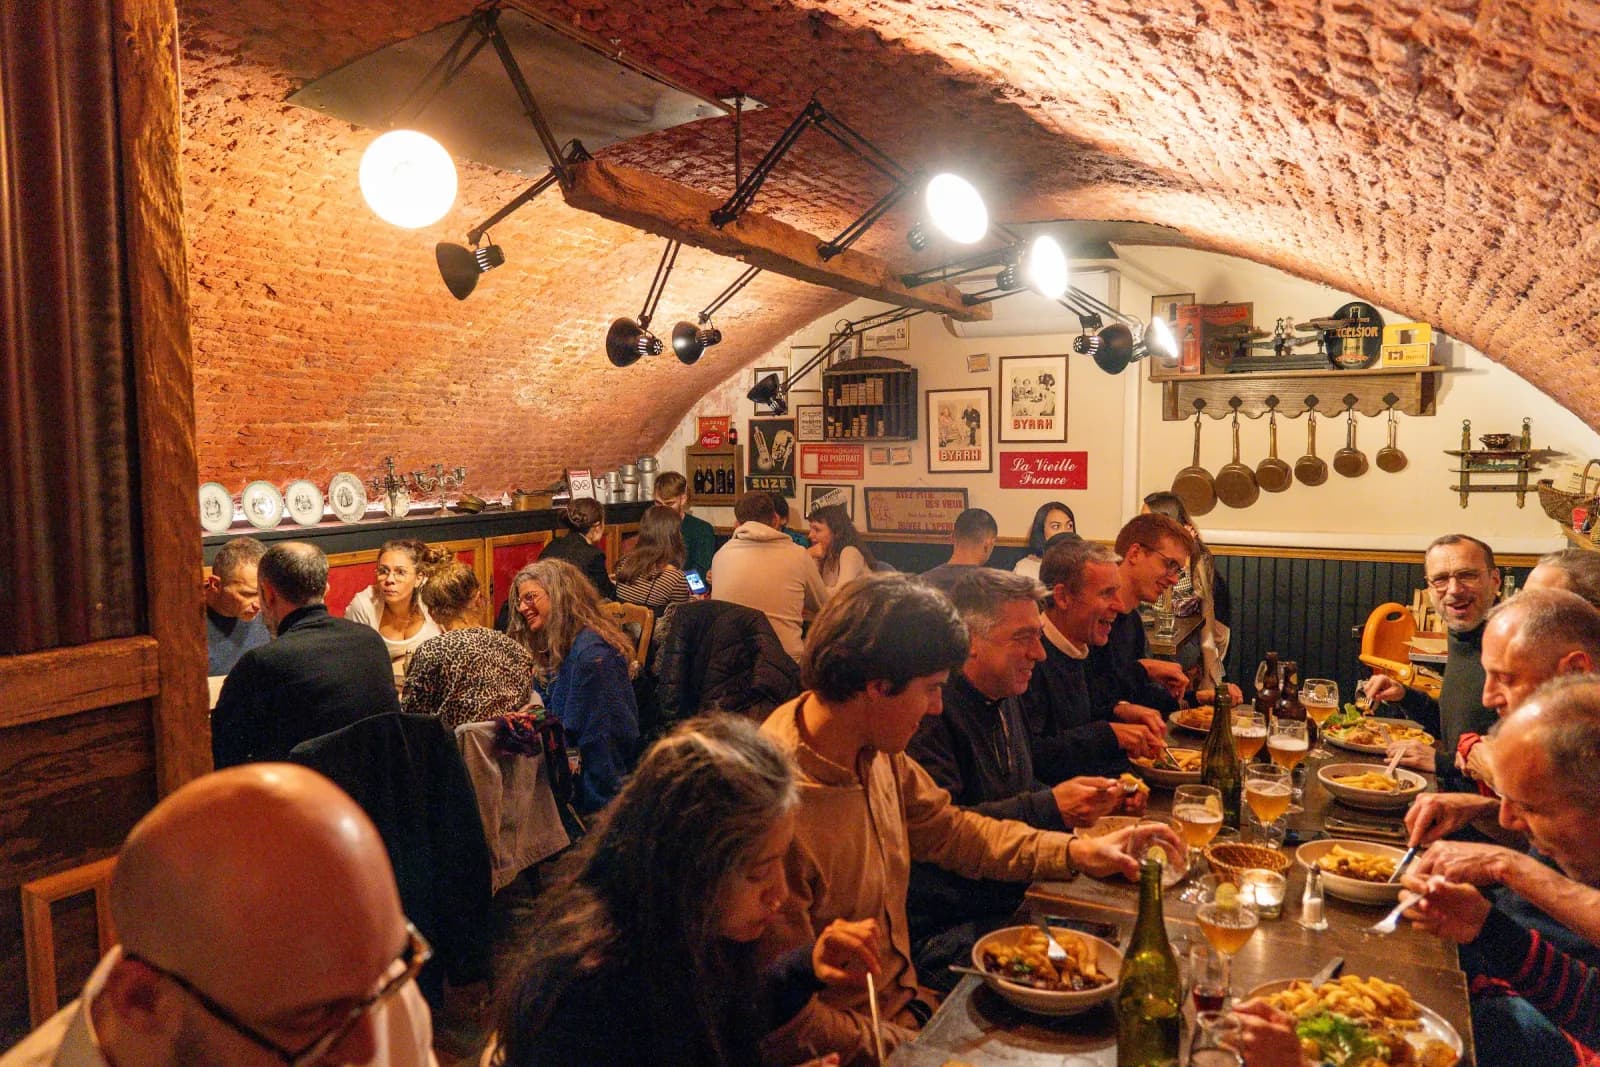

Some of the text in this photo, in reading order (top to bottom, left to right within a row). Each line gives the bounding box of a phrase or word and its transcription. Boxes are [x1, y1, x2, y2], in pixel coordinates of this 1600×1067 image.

[1336, 326, 1379, 338] XCELSIOR
[1013, 418, 1053, 430] BYRRH
[830, 454, 861, 465] PORTRAIT
[939, 450, 982, 461] BYRRH
[1010, 457, 1077, 472] La Vieille
[752, 478, 788, 489] SUZE
[1019, 471, 1068, 485] France
